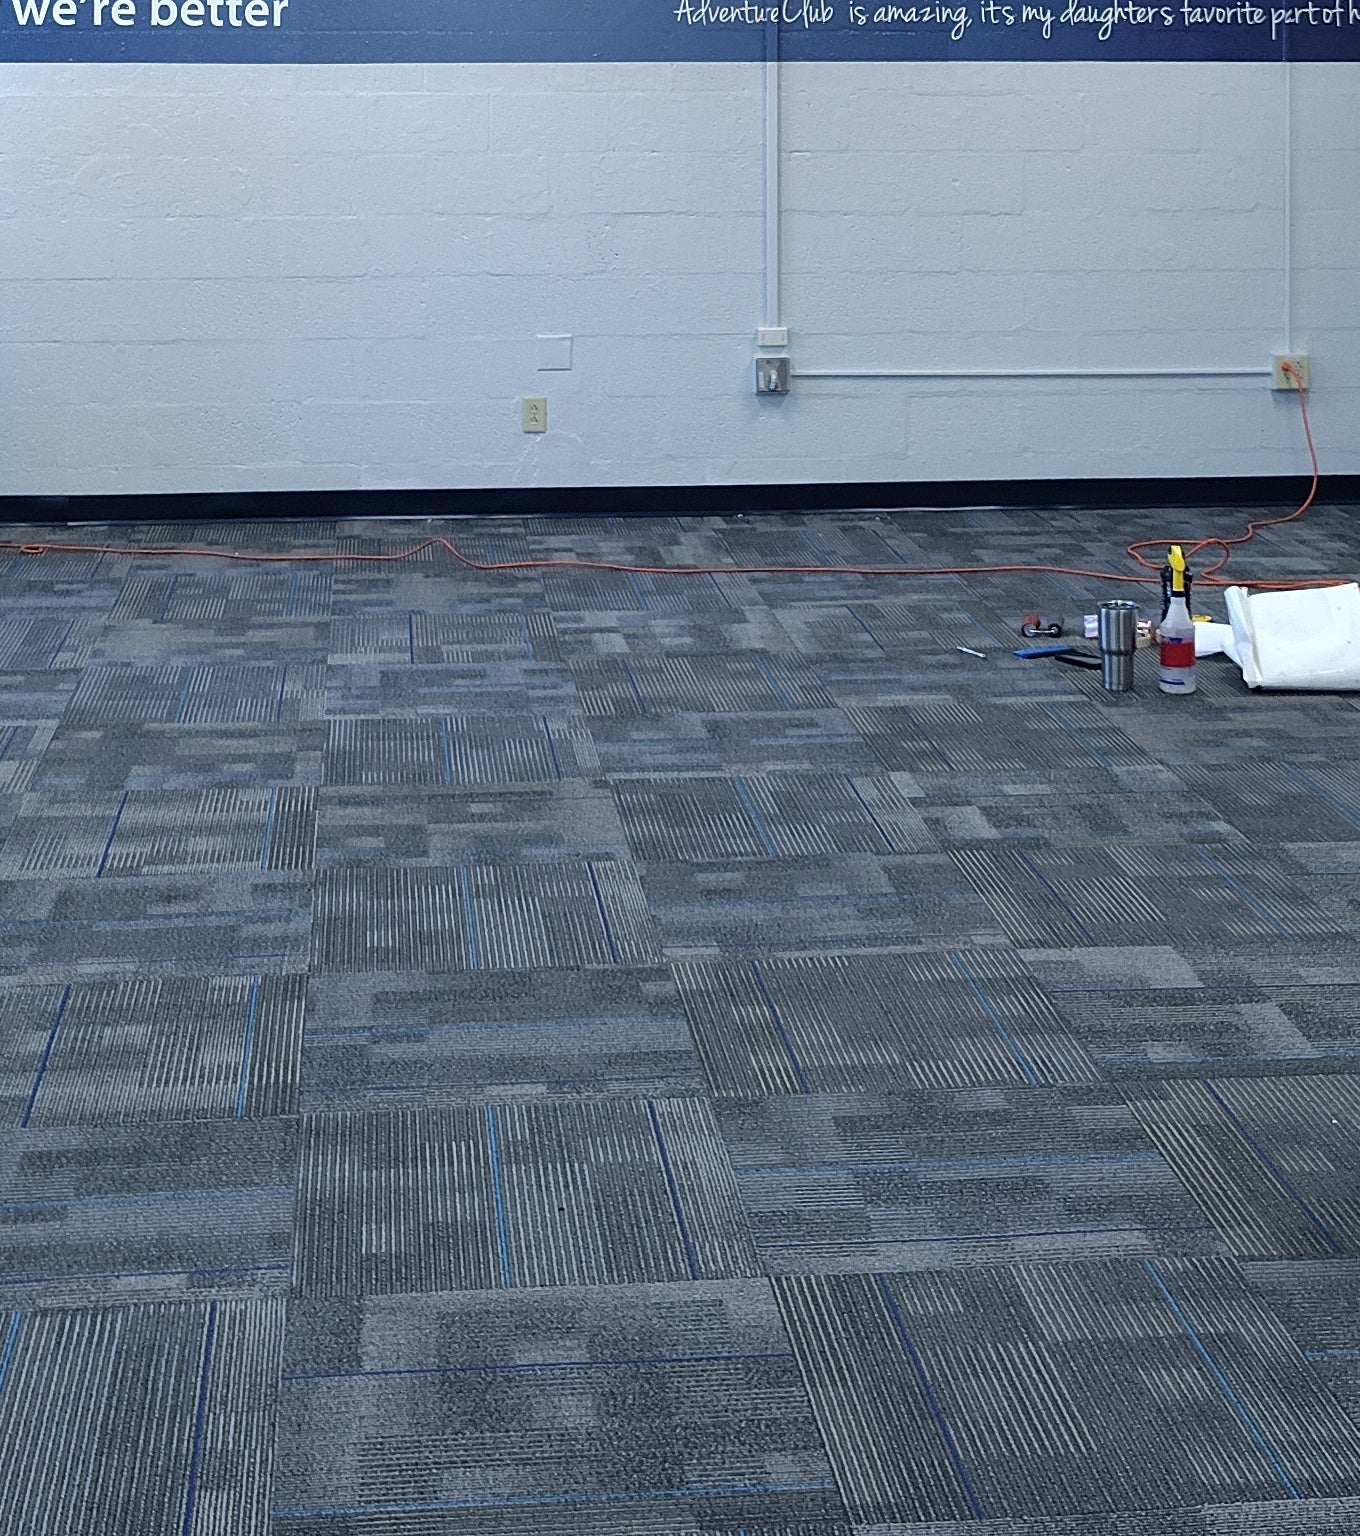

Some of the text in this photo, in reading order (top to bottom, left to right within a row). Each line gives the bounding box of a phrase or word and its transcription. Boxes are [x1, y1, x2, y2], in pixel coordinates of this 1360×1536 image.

[848, 0, 868, 25] is
[873, 0, 973, 40] amazing,
[1022, 4, 1056, 39] my
[1270, 1, 1320, 40] part
